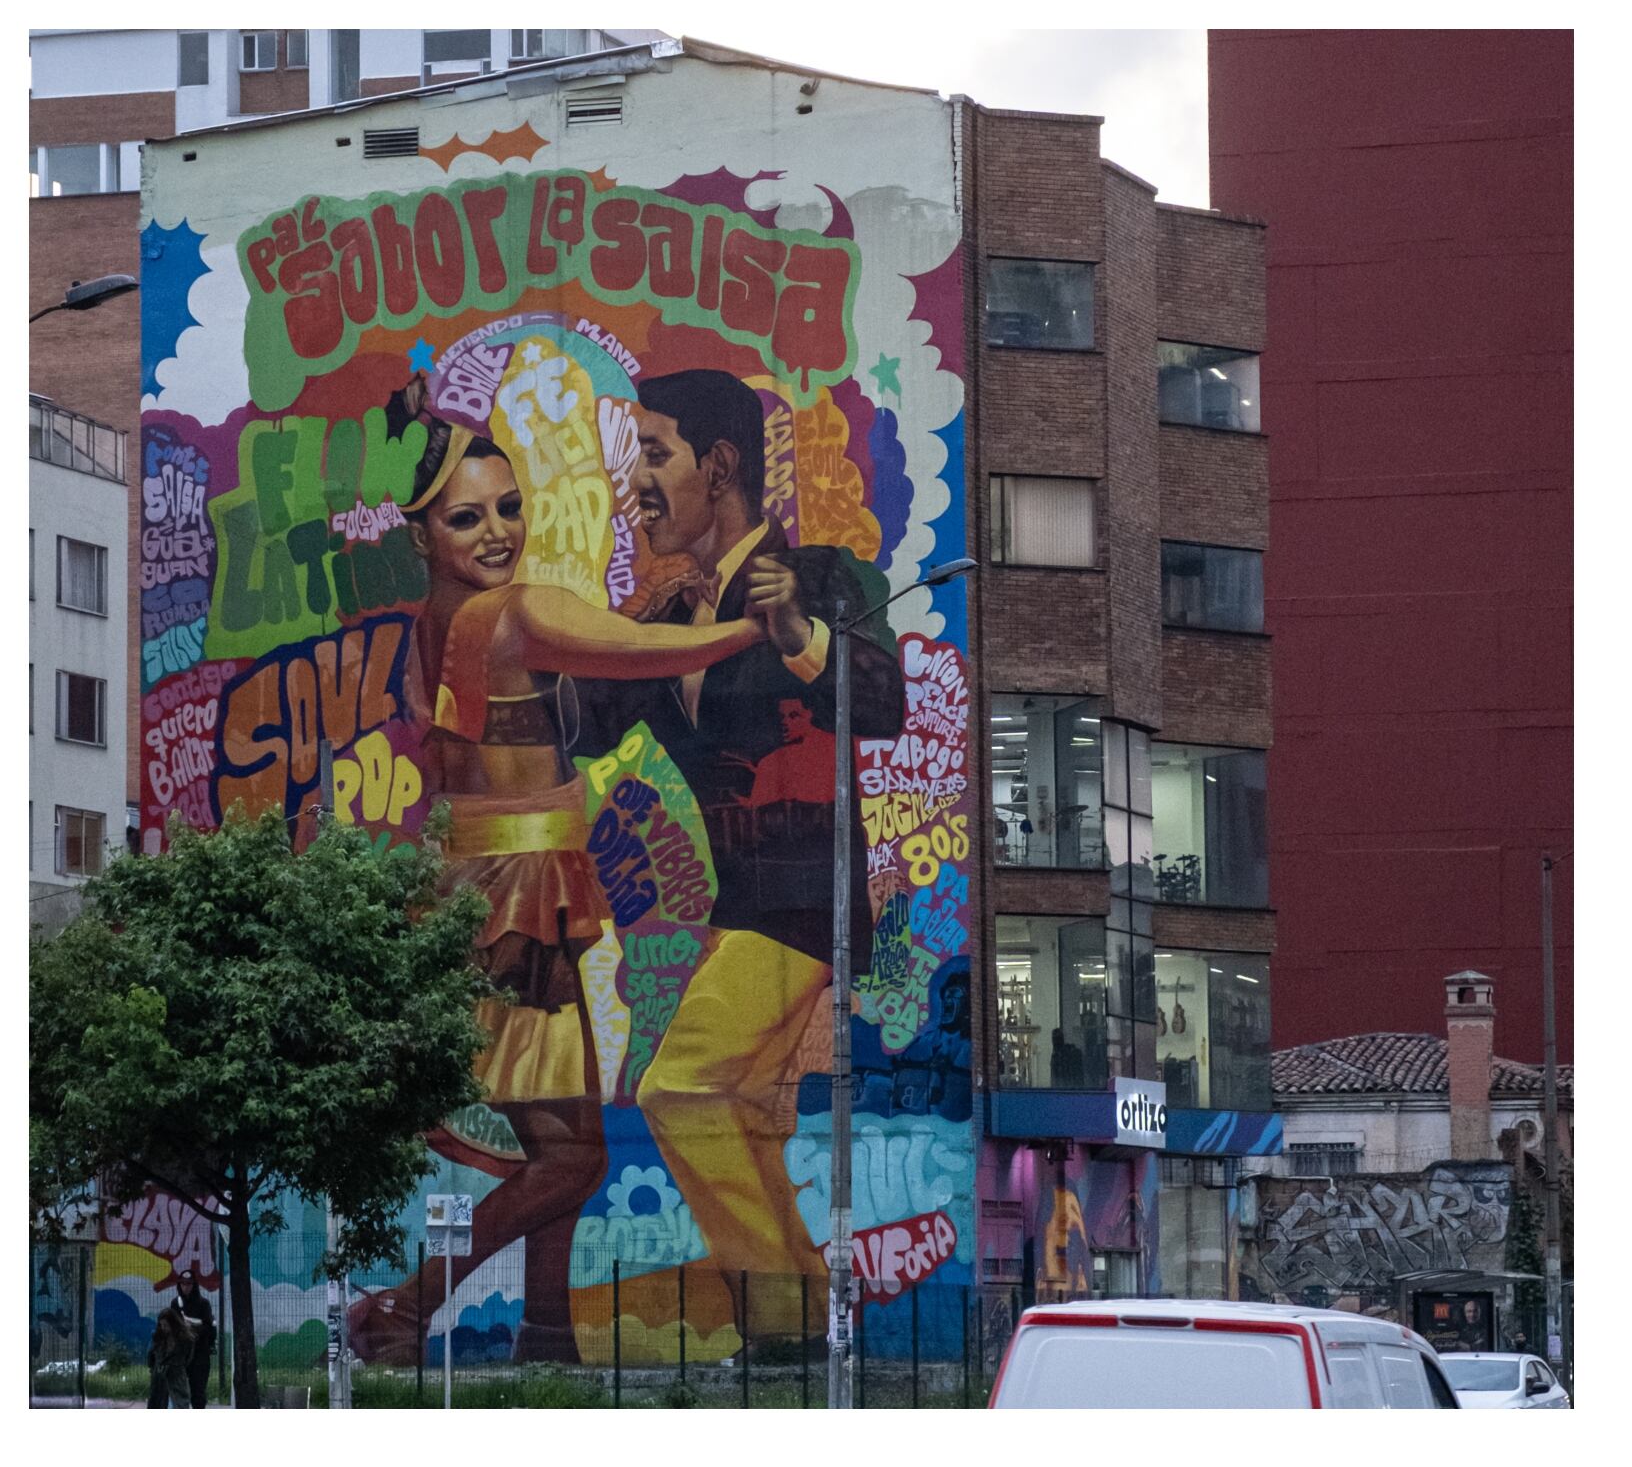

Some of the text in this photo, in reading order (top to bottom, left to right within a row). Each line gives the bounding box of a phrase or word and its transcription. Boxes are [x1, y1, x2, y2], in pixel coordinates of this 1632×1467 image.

[435, 314, 522, 375] METIENDO
[146, 698, 218, 763] quiero
[217, 622, 404, 823] SOUL
[905, 680, 968, 729] PEACE
[333, 731, 422, 825] POP
[859, 766, 968, 811] SPRAYERS
[935, 861, 969, 905] PA
[1121, 1094, 1169, 1133] ortizo
